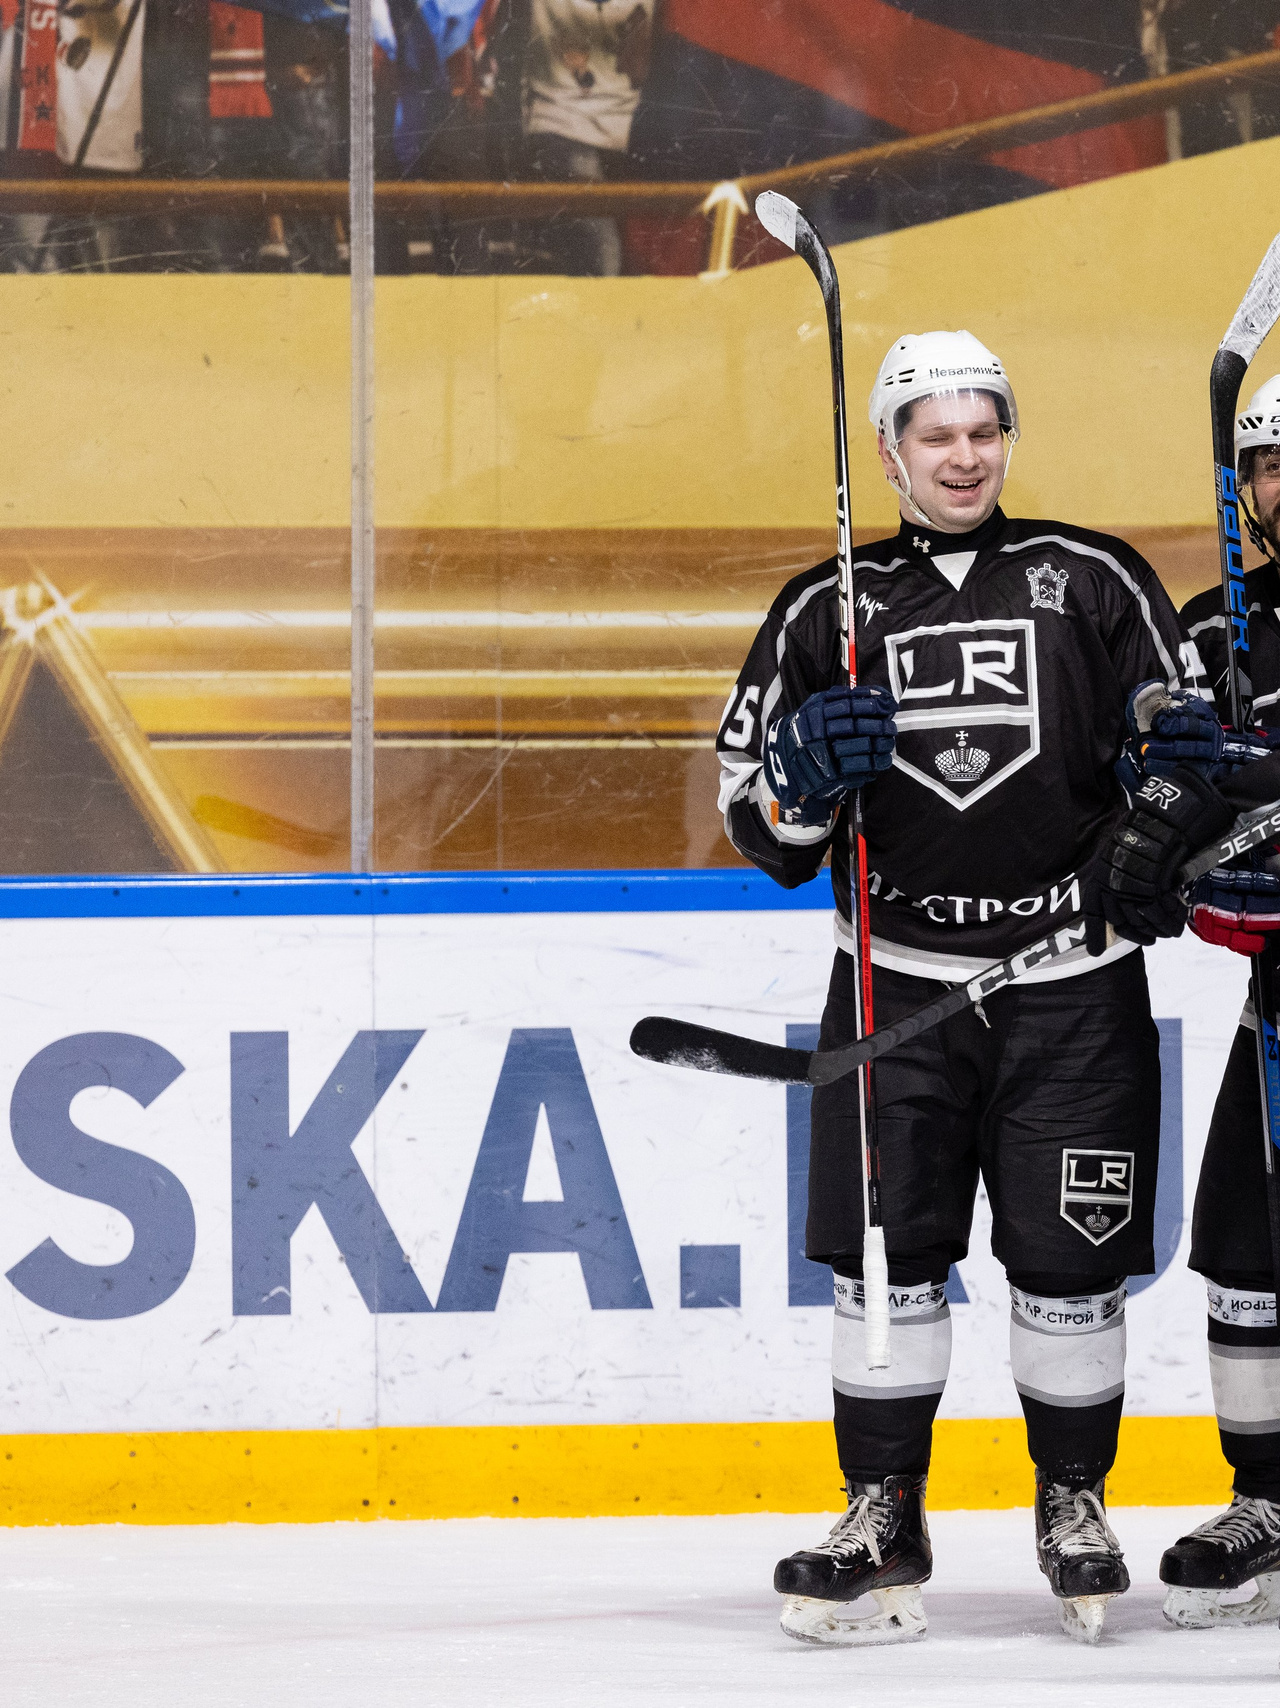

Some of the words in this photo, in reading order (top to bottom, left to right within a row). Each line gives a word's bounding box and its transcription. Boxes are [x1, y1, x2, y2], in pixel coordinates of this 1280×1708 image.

[899, 640, 1025, 699] LR
[1067, 1158, 1127, 1191] LR
[1231, 1299, 1276, 1313] СТРОЙ
